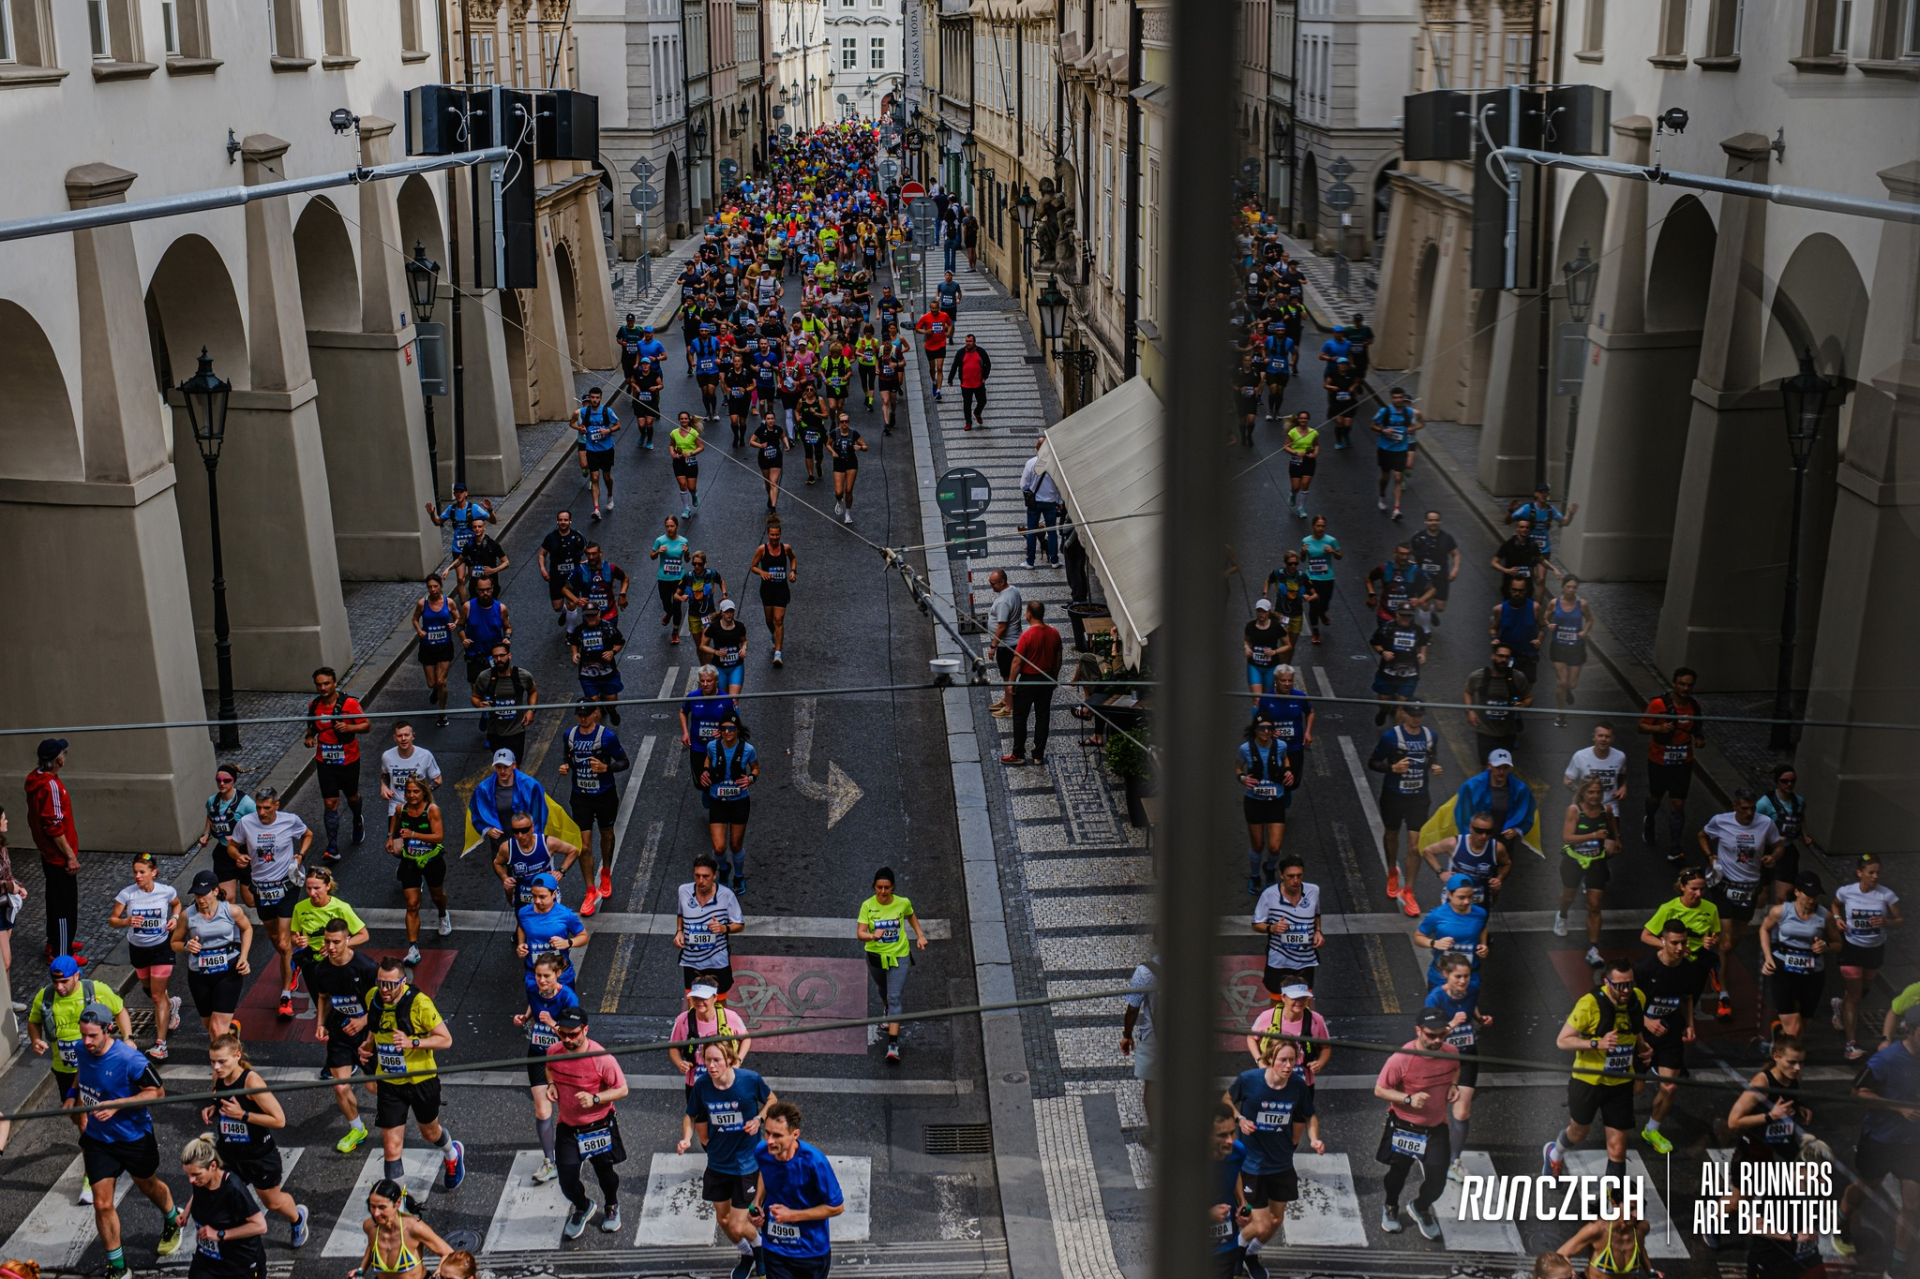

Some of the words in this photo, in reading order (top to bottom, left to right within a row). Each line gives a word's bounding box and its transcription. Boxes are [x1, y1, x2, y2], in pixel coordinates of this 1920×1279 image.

[911, 10, 920, 38] MÓDA
[913, 41, 921, 77] PÁNSKÁ
[694, 934, 711, 943] 5187
[201, 955, 225, 967] F1469
[380, 1056, 402, 1067] 5066
[717, 1113, 735, 1123] 5177
[223, 1123, 246, 1134] F1489
[584, 1137, 607, 1151] 5810
[771, 1224, 795, 1236] 4990
